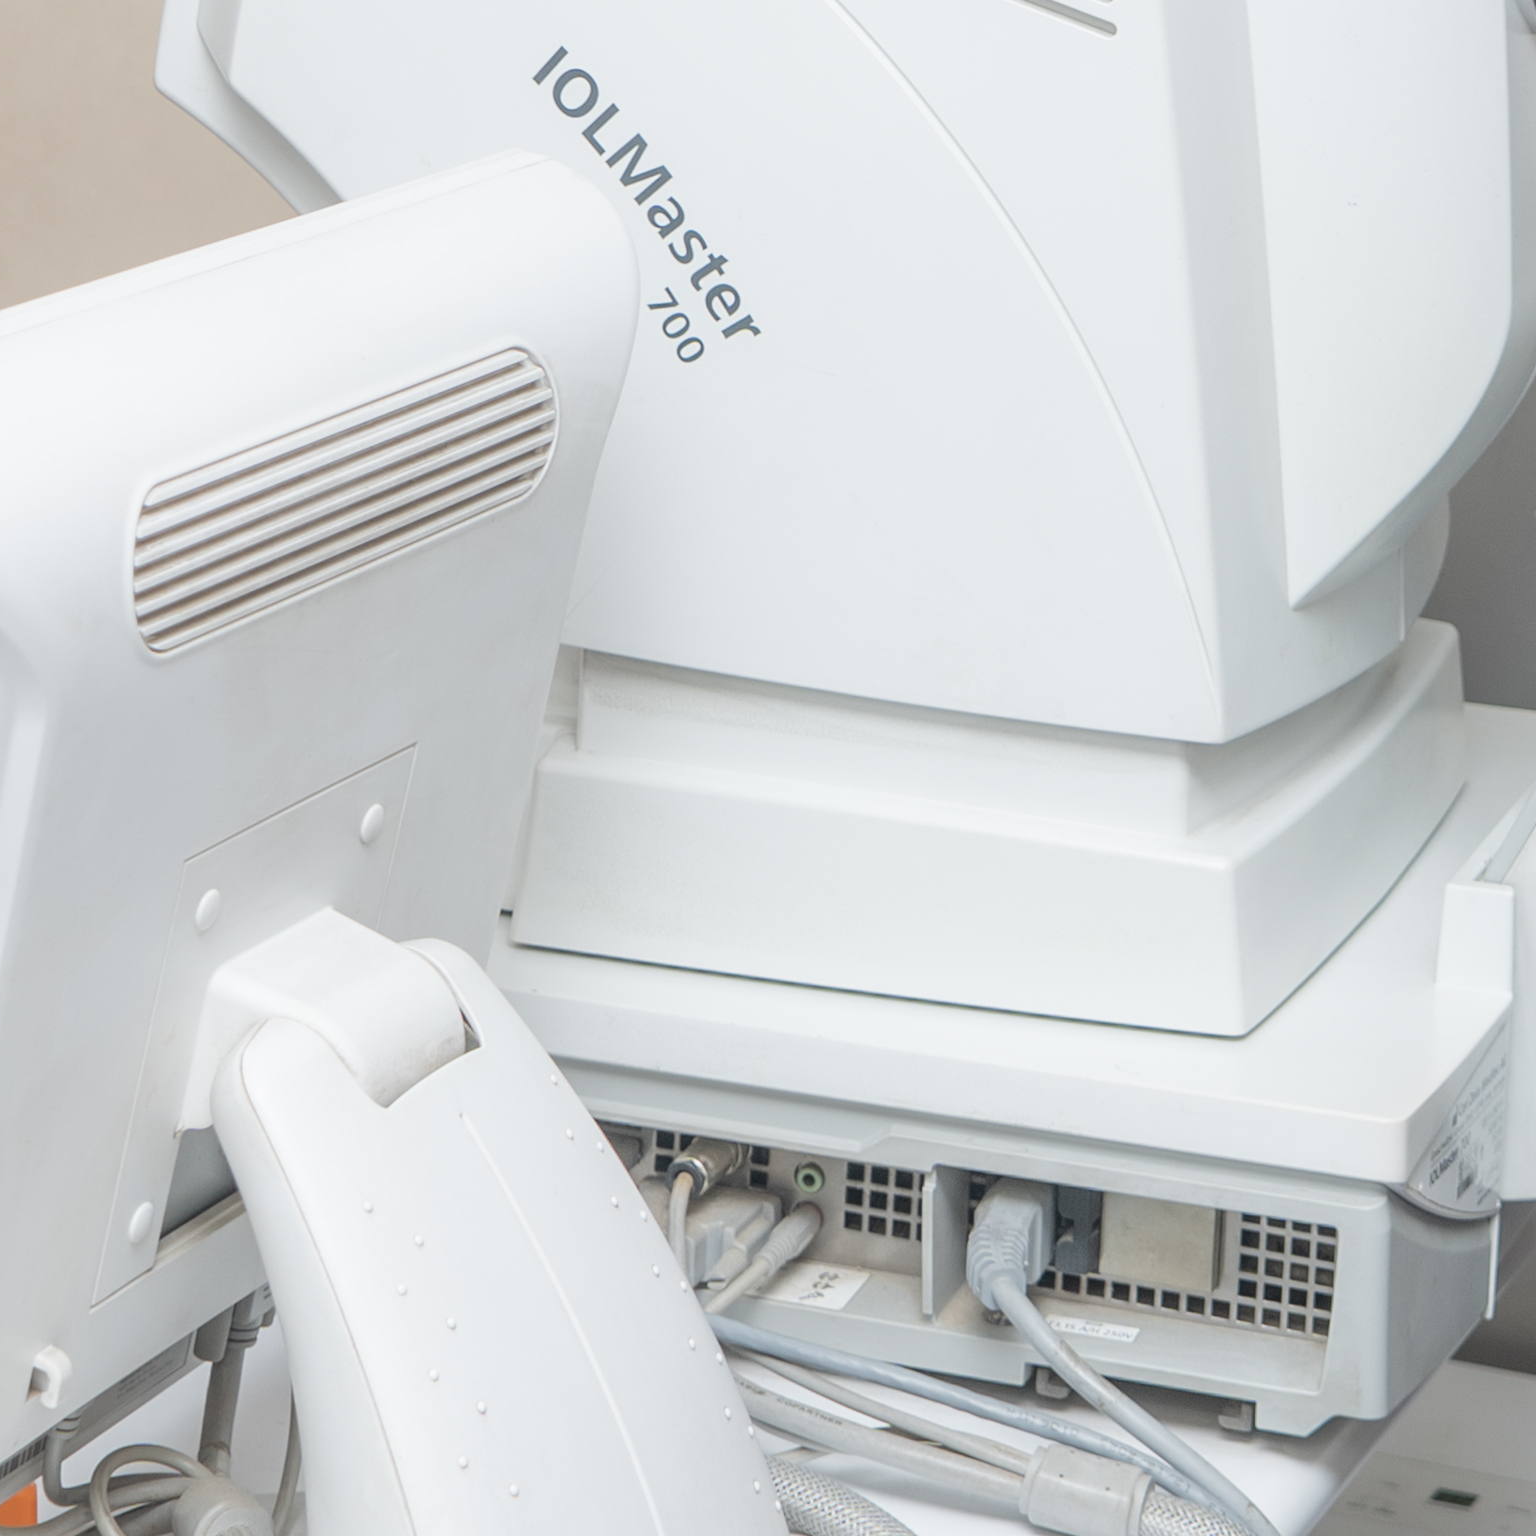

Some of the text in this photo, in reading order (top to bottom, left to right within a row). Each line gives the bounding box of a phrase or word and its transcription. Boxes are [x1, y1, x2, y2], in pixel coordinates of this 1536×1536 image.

[532, 45, 761, 340] IOLMaster
[647, 287, 705, 363] 700
[777, 1398, 843, 1426] COPARTNER
